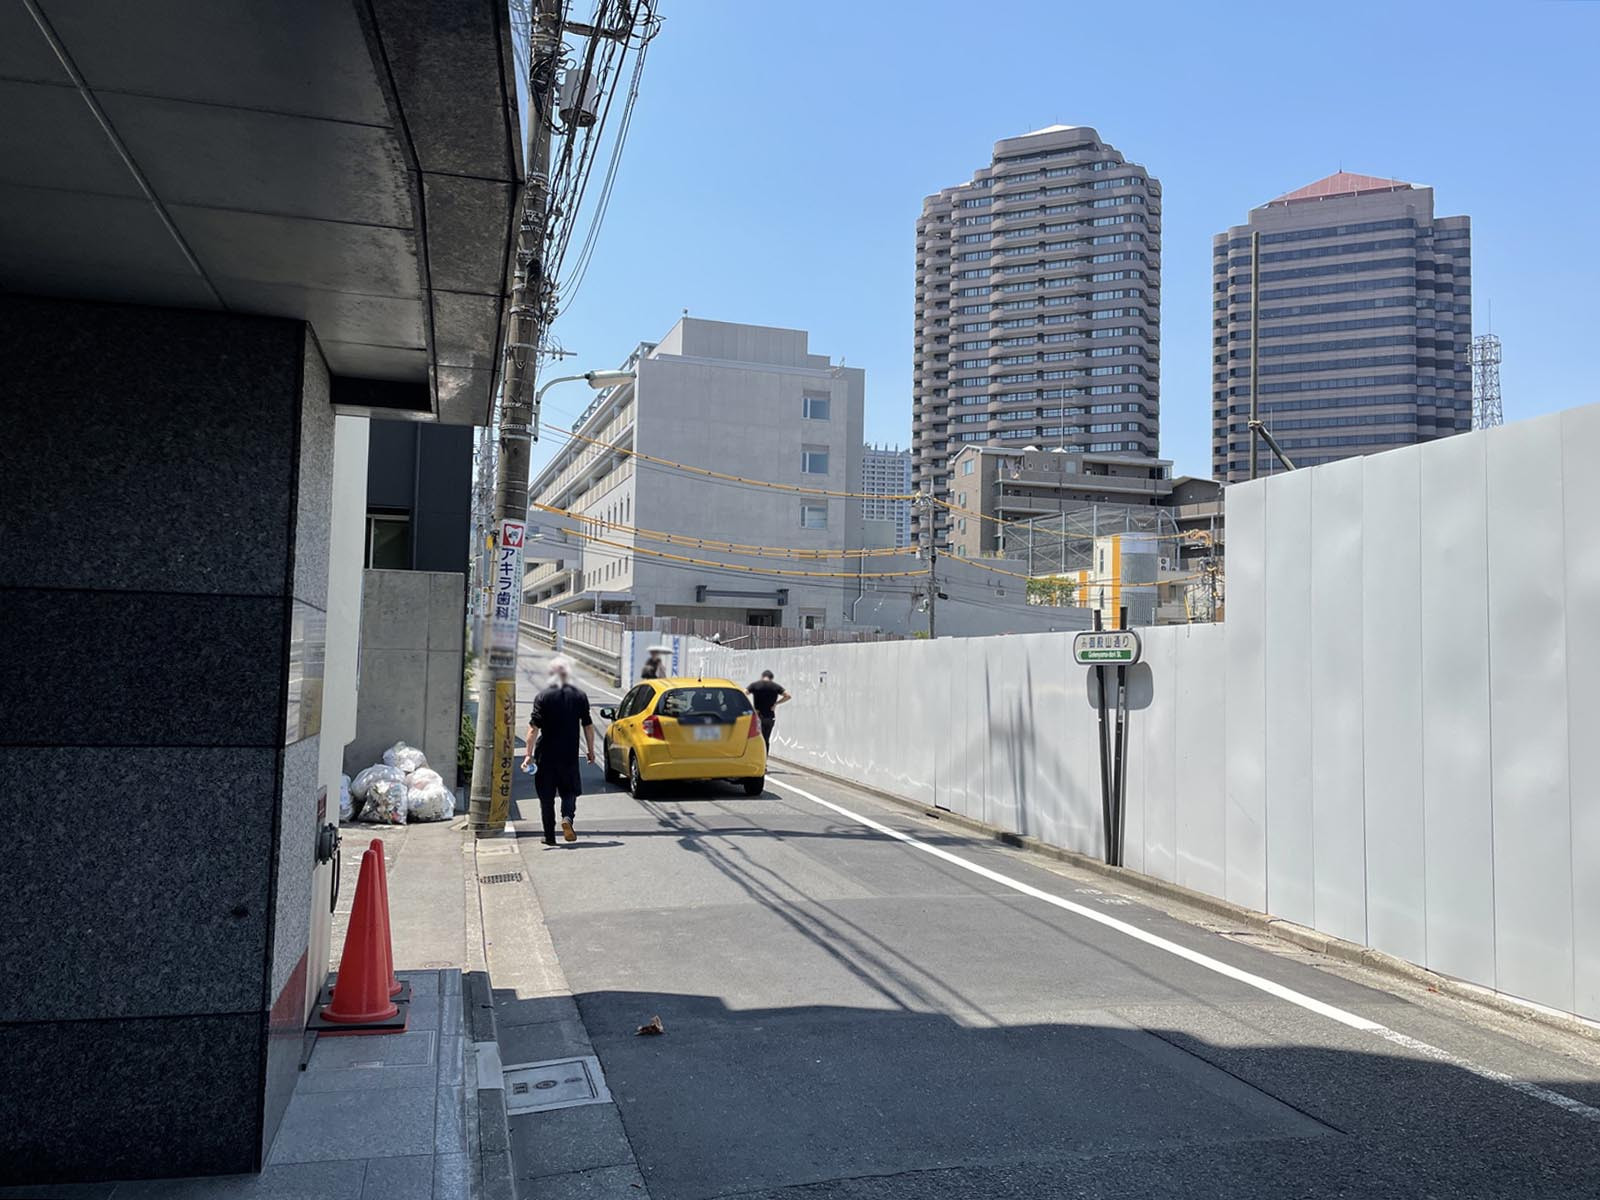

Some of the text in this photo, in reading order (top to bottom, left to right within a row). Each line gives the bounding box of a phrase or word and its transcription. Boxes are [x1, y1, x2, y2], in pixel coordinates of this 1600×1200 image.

[496, 548, 516, 620] アキラ歯科
